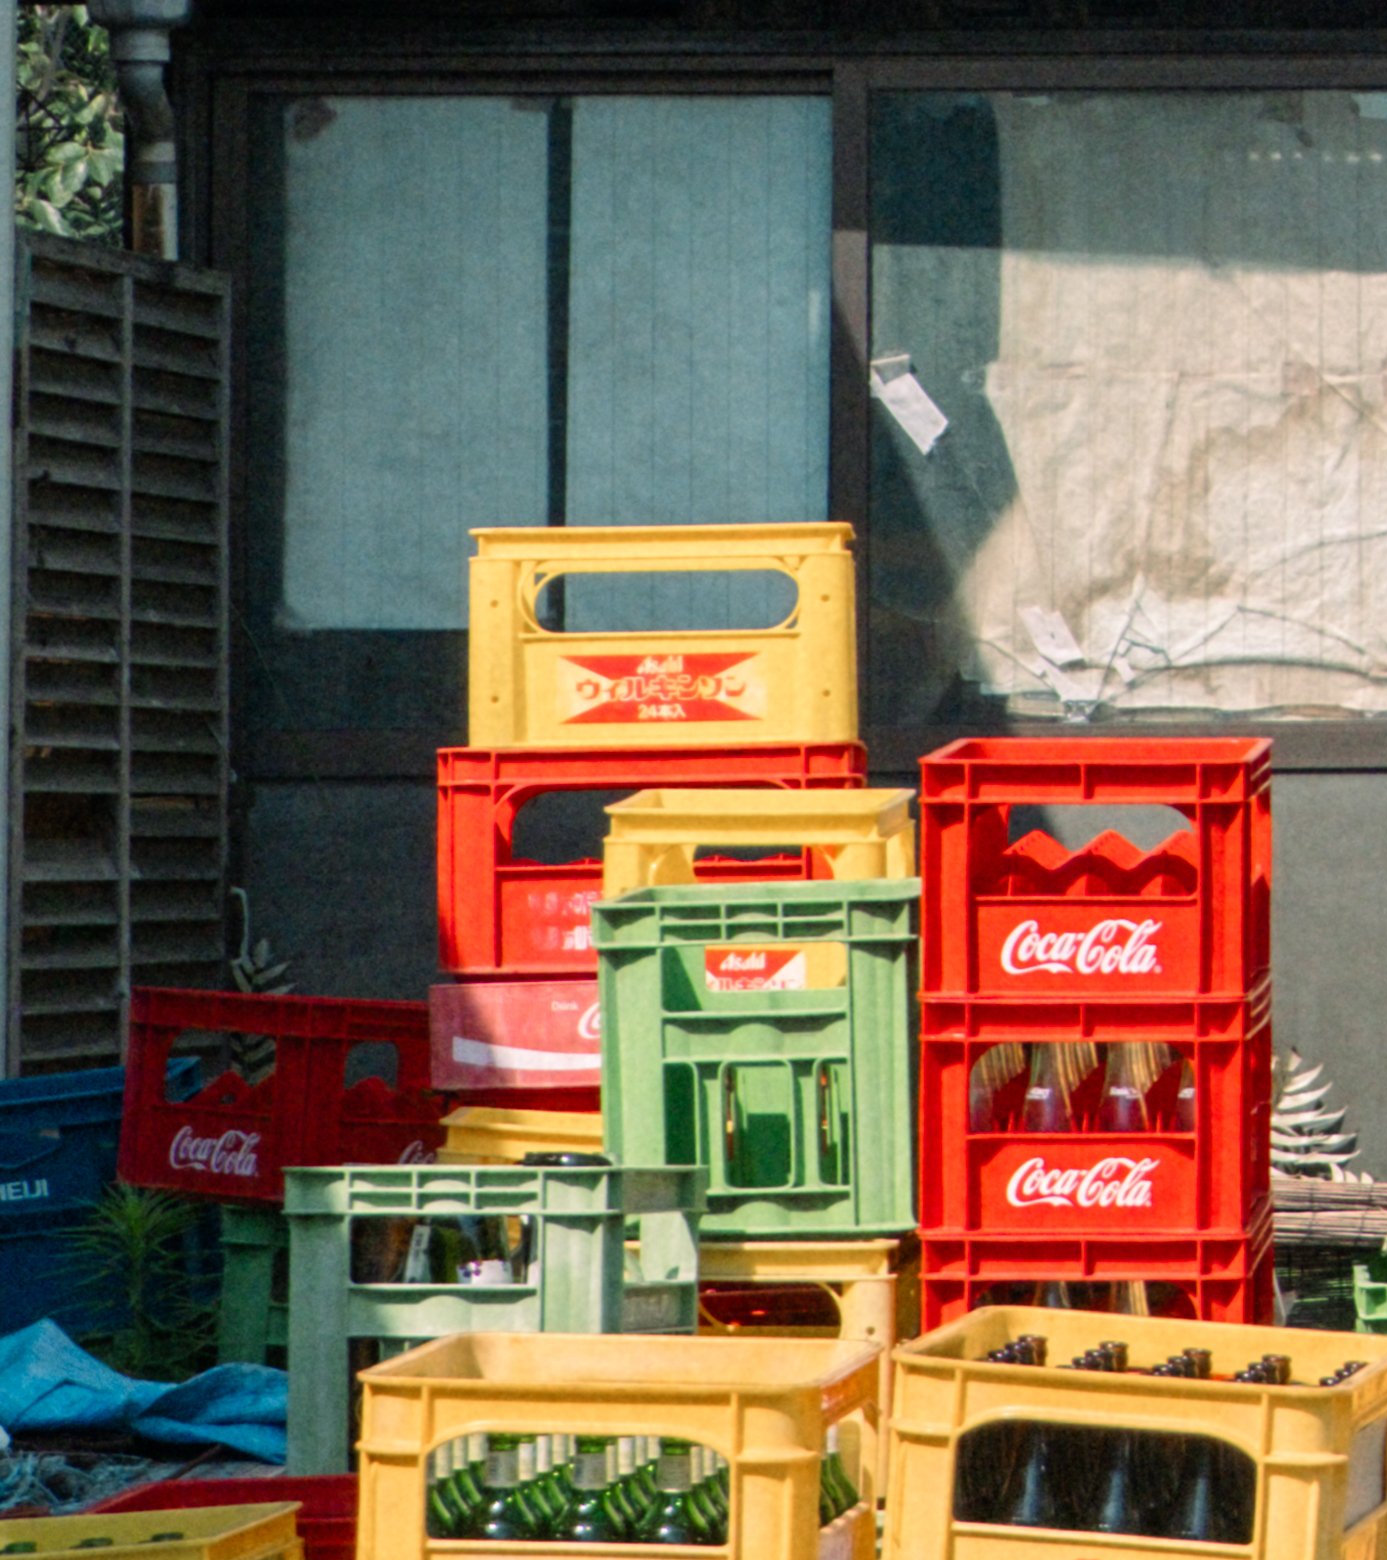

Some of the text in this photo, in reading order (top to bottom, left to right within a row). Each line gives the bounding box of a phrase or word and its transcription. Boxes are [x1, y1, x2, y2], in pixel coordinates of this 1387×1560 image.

[636, 655, 684, 674] Asahi
[576, 675, 747, 701] ウィルキンソン
[720, 952, 765, 971] Asahi
[1000, 919, 1162, 974] Coca-Cola
[169, 1126, 260, 1177] Coca-Cola
[1006, 1157, 1160, 1207] Coca-Cola
